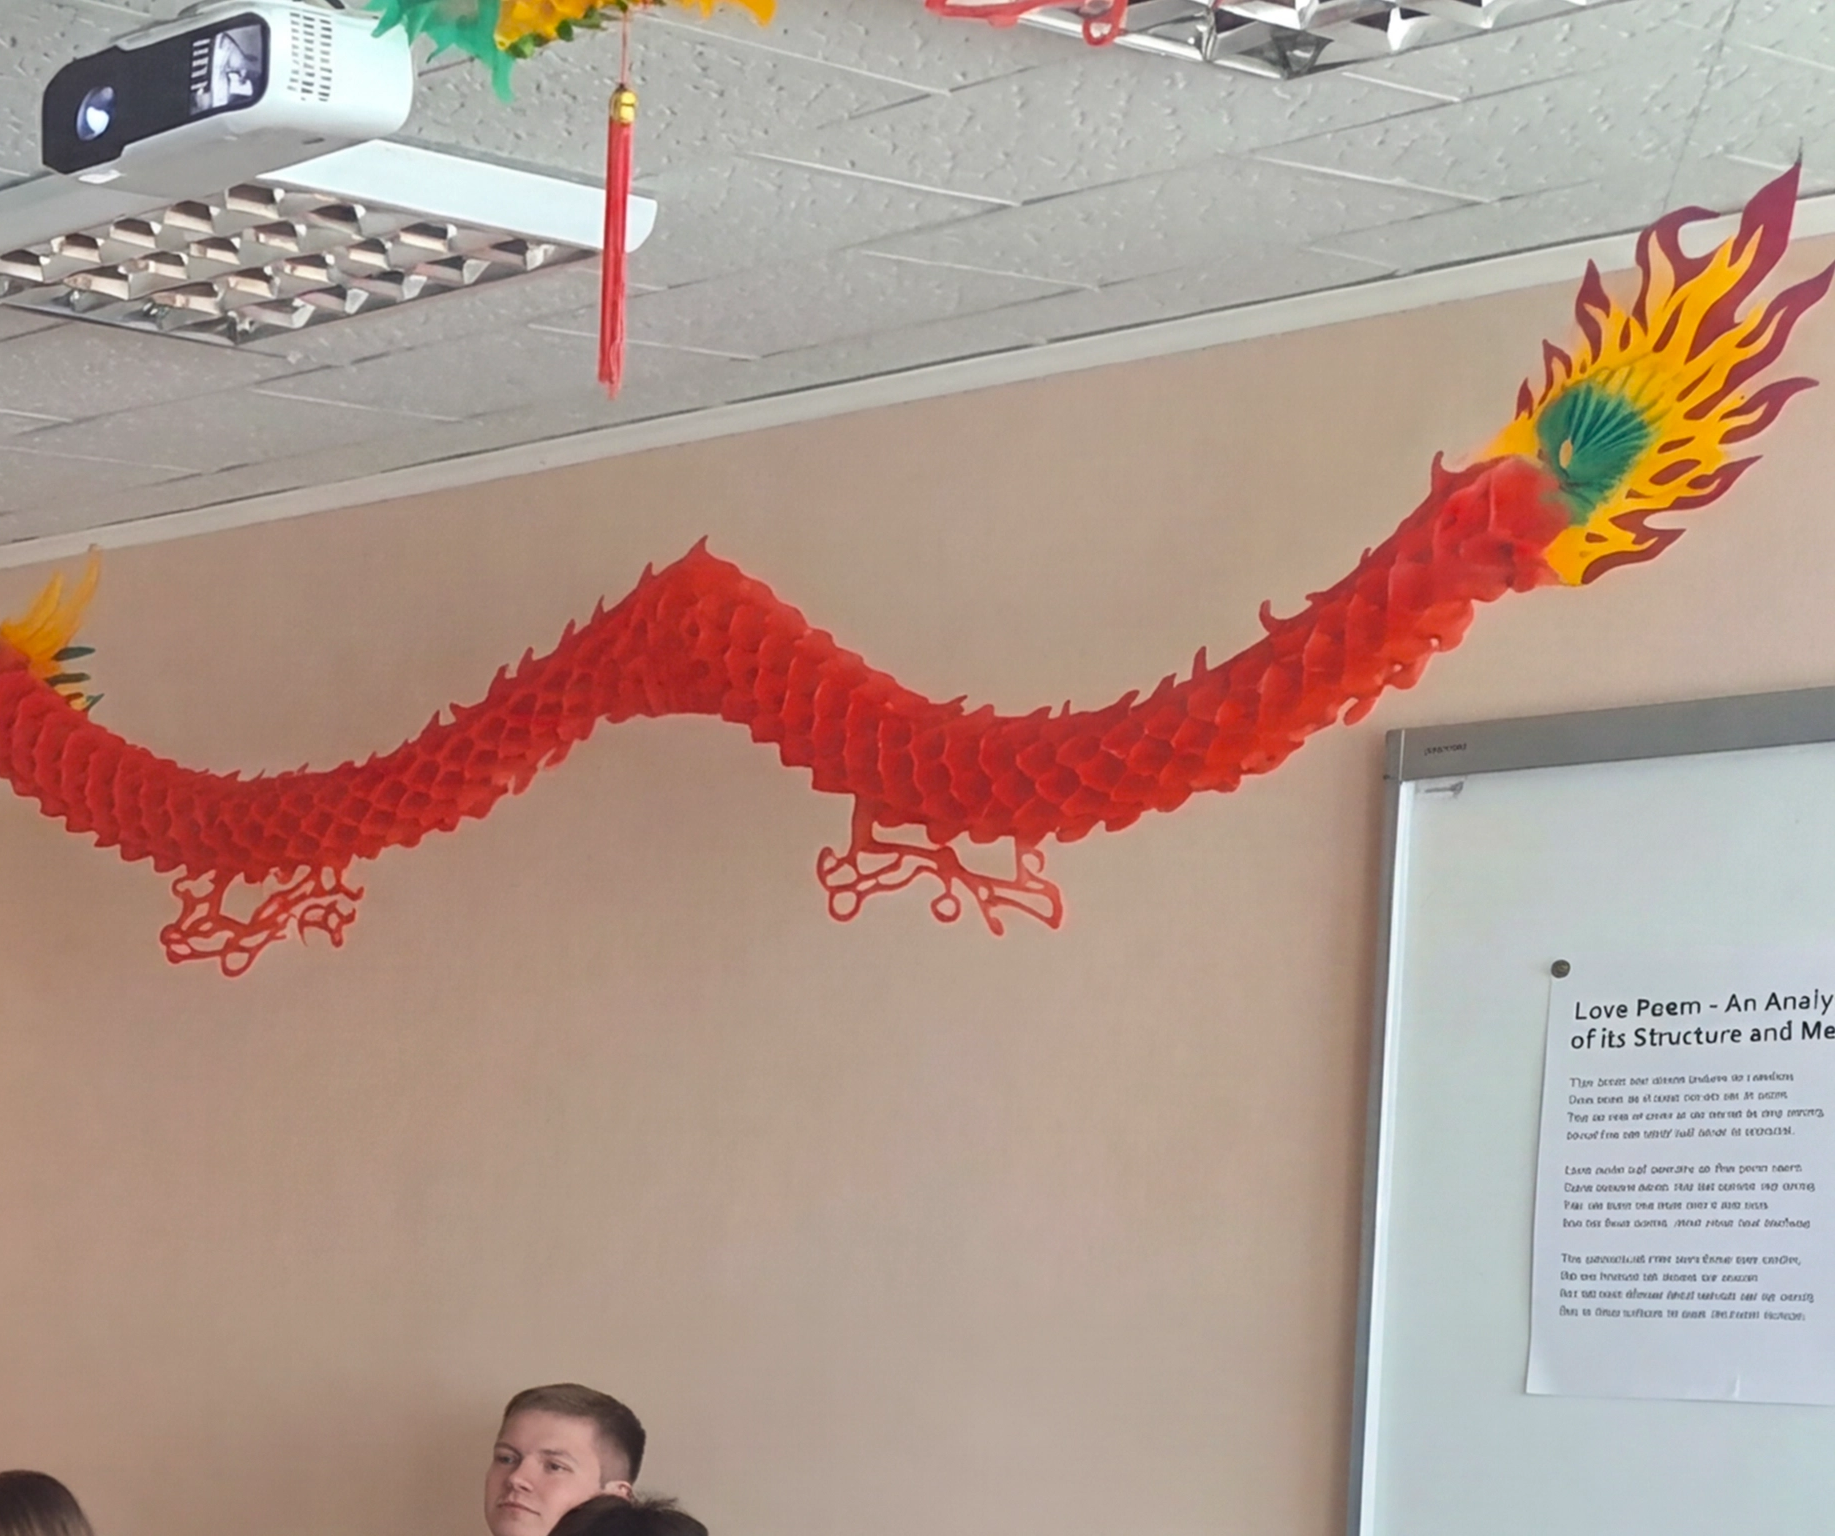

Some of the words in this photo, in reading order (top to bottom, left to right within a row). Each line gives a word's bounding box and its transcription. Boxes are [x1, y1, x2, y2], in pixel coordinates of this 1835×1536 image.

[1575, 1001, 1628, 1020] Love
[1724, 993, 1757, 1013] An
[1570, 1027, 1597, 1049] of
[1601, 1027, 1626, 1048] its
[1634, 1026, 1742, 1047] Structure
[1750, 1020, 1793, 1043] and
[1801, 1020, 1835, 1041] Me
